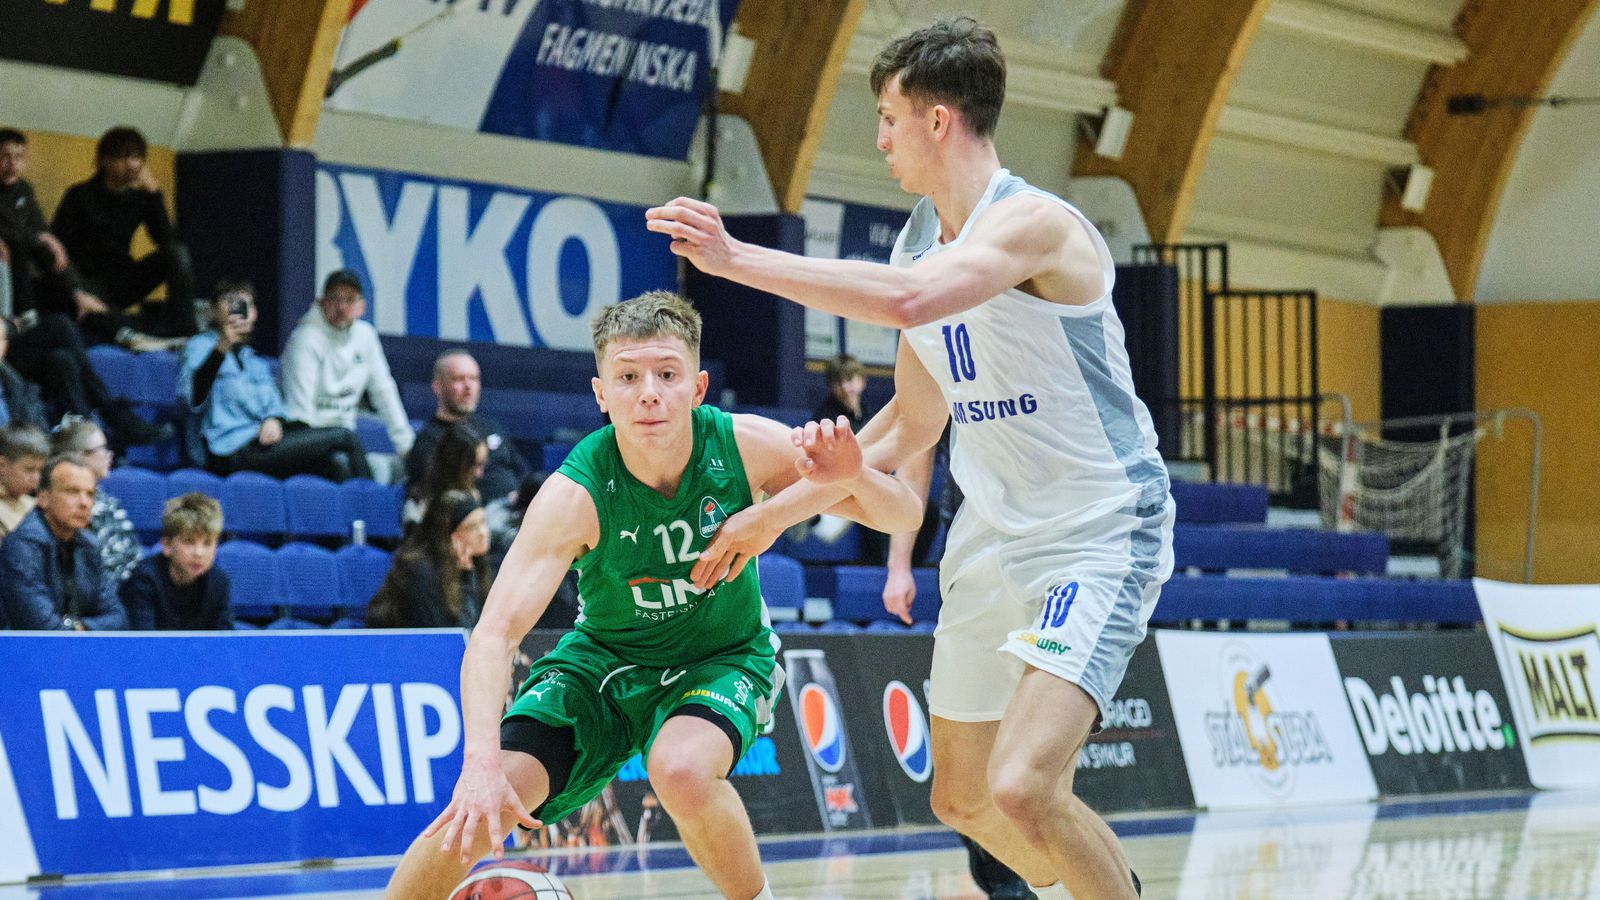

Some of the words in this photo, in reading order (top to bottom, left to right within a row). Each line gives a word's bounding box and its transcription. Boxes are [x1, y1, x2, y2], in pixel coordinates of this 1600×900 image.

[941, 322, 977, 383] 10
[653, 519, 701, 565] 12
[630, 577, 708, 609] LIN
[1040, 581, 1080, 631] 10
[681, 688, 742, 713] SUBWAY
[1517, 650, 1598, 719] MALT
[39, 682, 462, 820] NESSKIP
